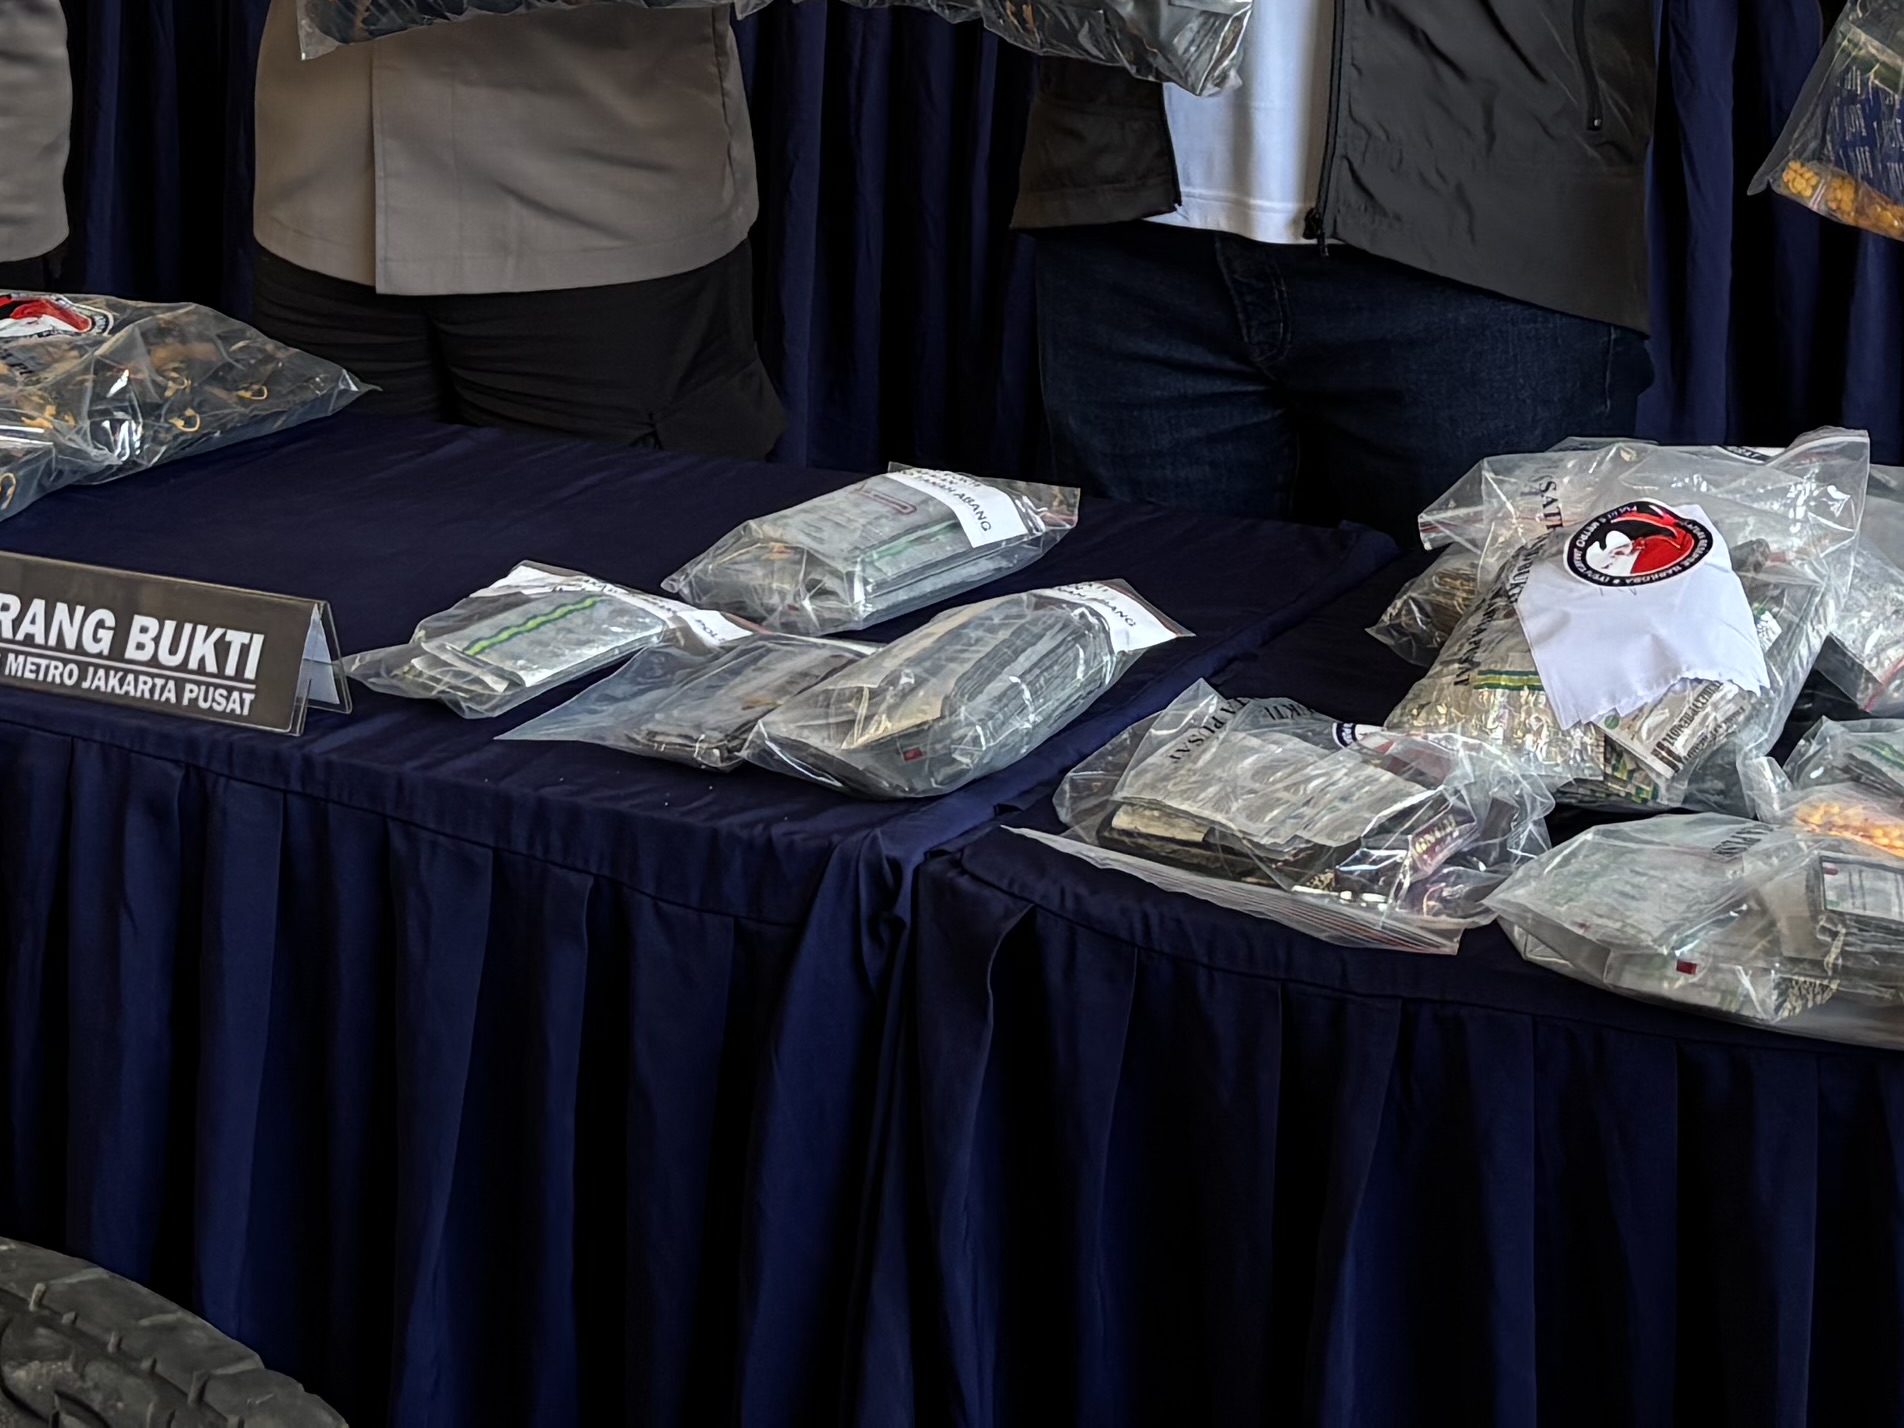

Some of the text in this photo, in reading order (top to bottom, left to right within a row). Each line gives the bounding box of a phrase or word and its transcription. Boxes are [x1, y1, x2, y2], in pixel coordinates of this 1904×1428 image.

[124, 616, 265, 681] BUKTI
[4, 652, 79, 686] METRO
[83, 666, 176, 705] JAKARTA
[183, 684, 256, 718] PUSAT
